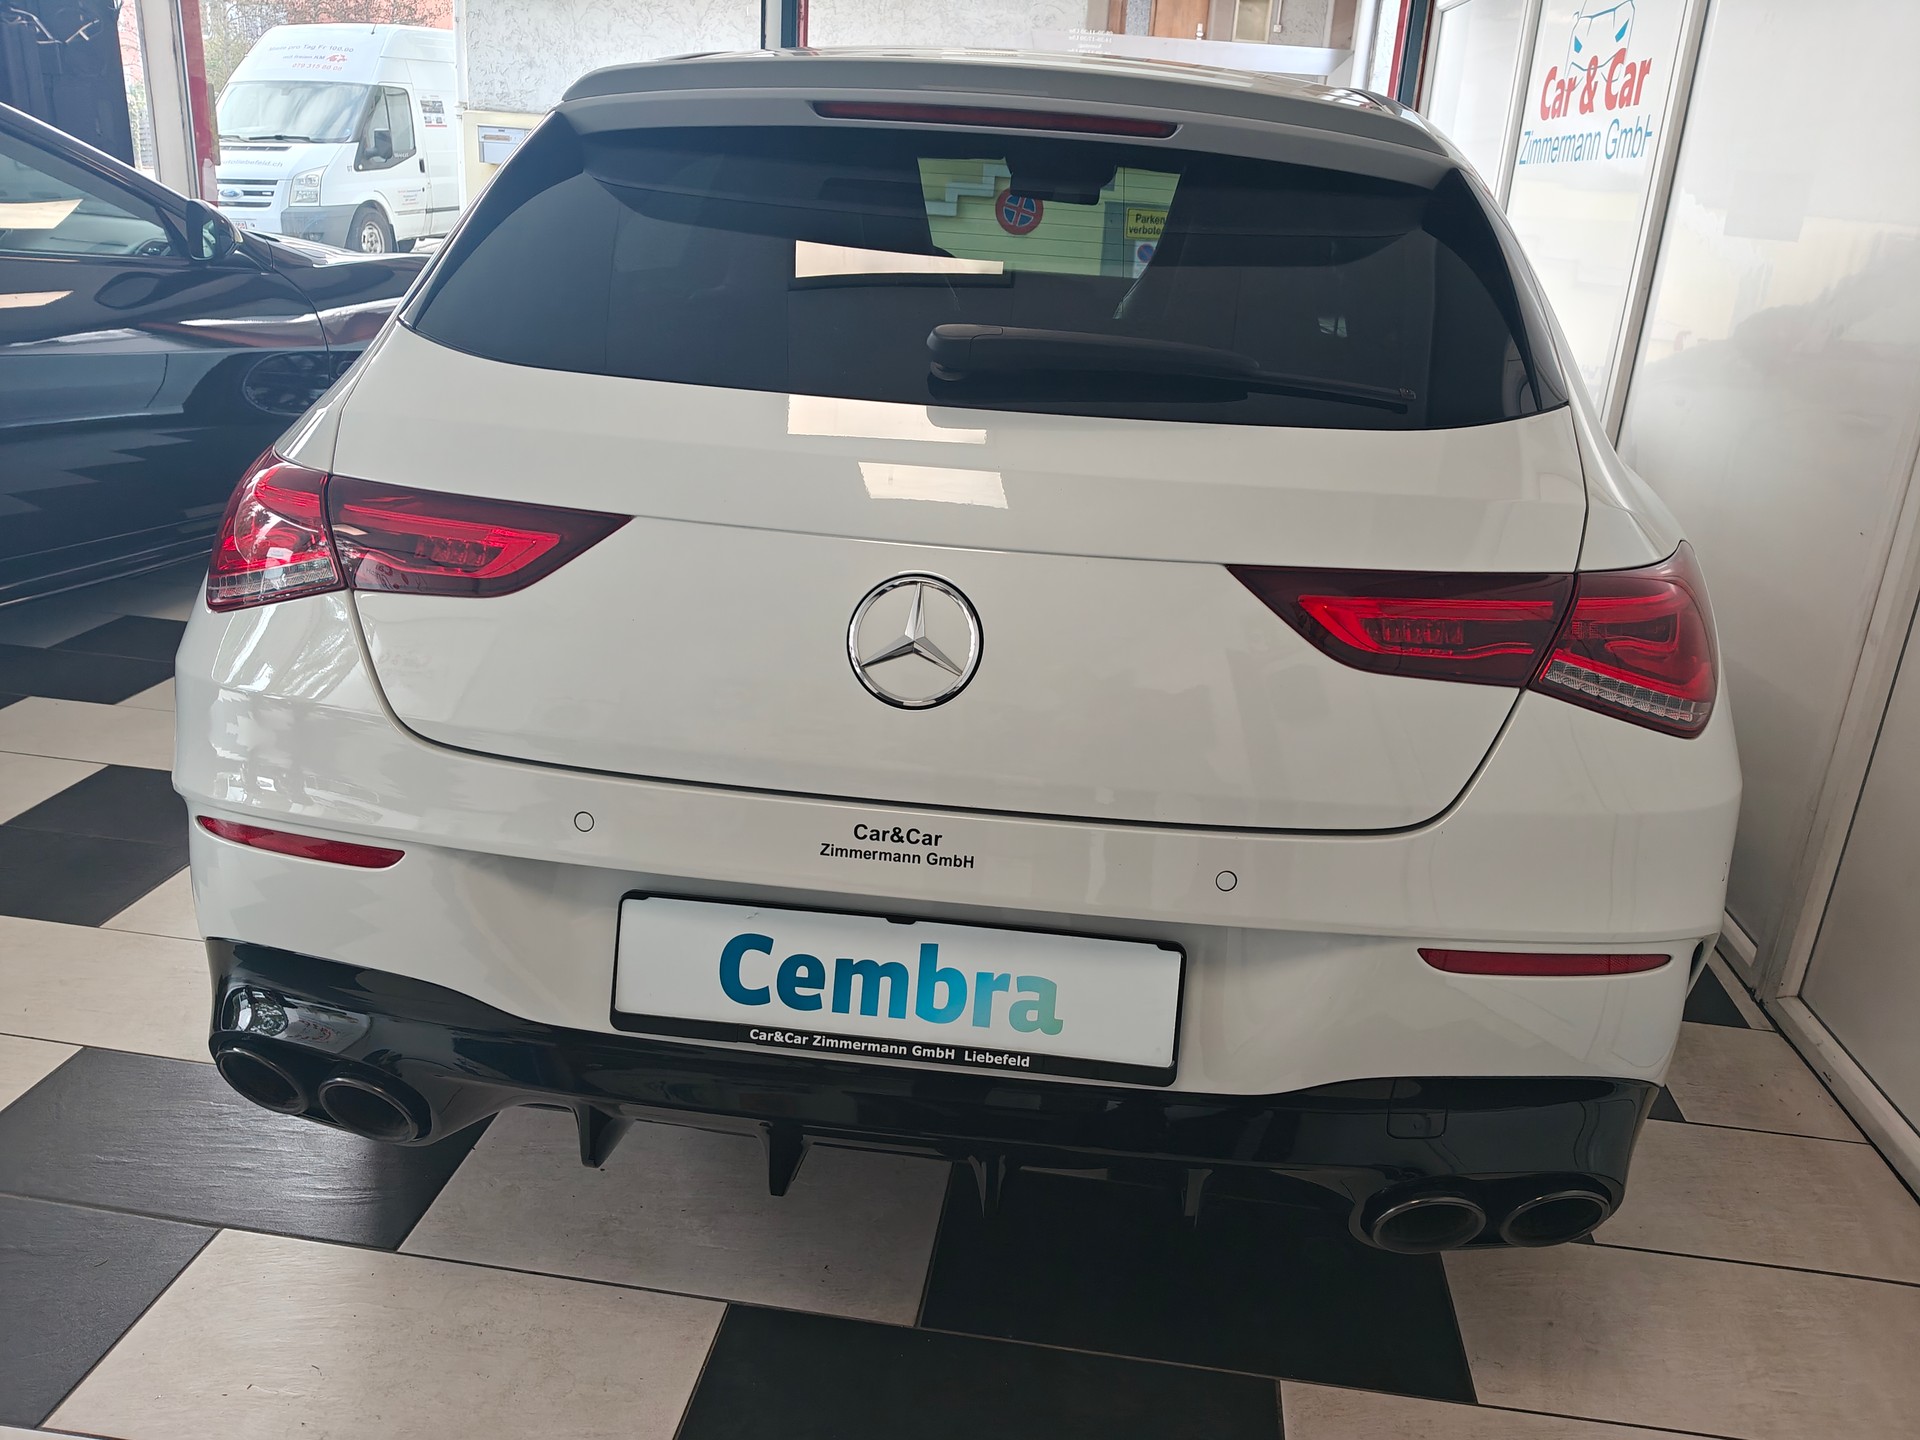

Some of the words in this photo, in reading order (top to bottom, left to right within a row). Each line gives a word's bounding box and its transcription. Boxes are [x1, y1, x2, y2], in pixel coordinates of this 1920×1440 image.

[1540, 66, 1577, 121] Car
[1579, 55, 1599, 115] &
[1604, 47, 1652, 111] Car
[1519, 130, 1602, 165] Zimmermann
[1129, 225, 1162, 235] verbote
[1135, 213, 1166, 225] Parken
[853, 823, 943, 847] Car&Car
[819, 843, 921, 865] Zimmermann
[926, 852, 975, 869] GmbH
[719, 932, 1064, 1036] Cembra
[749, 1028, 810, 1046] Car&Car
[812, 1035, 908, 1056] Zimmermann
[911, 1045, 956, 1061] GmbH
[964, 1049, 1031, 1068] Liebefeld
